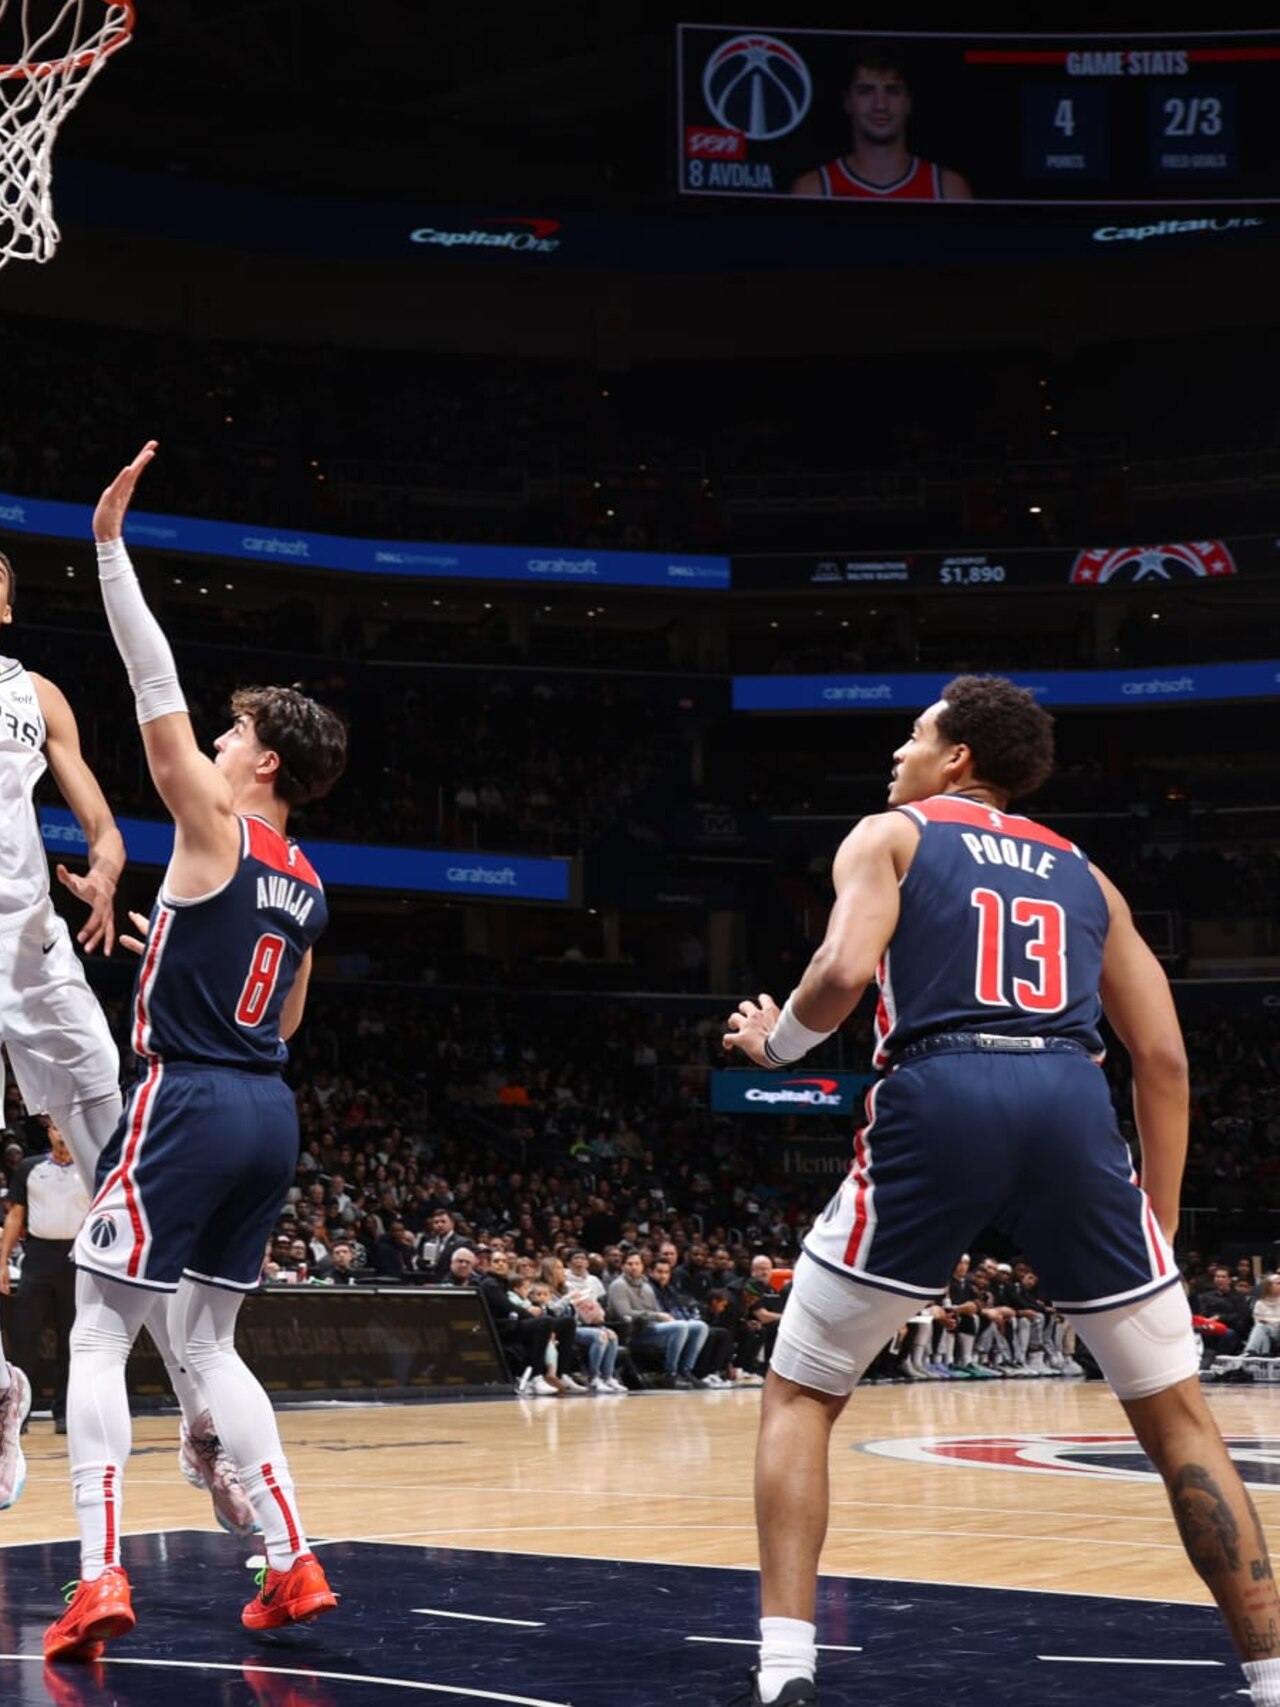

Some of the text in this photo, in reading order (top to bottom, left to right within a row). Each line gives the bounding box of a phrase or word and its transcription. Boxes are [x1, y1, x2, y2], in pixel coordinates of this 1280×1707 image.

[1065, 50, 1189, 76] GAME STATS
[1054, 97, 1223, 137] 4 2/3
[689, 160, 773, 188] 8 AVDIJA
[242, 535, 310, 558] carahsoft
[527, 557, 598, 576] carahsoft
[939, 566, 1006, 585] $1,890
[823, 684, 893, 701] carahsoft
[1122, 676, 1195, 695] carahsoft
[961, 832, 1057, 879] POOLE
[446, 866, 517, 886] carahsoft
[256, 875, 315, 927] AVDIJA
[970, 887, 1067, 1014] 13
[234, 932, 286, 1028] 8
